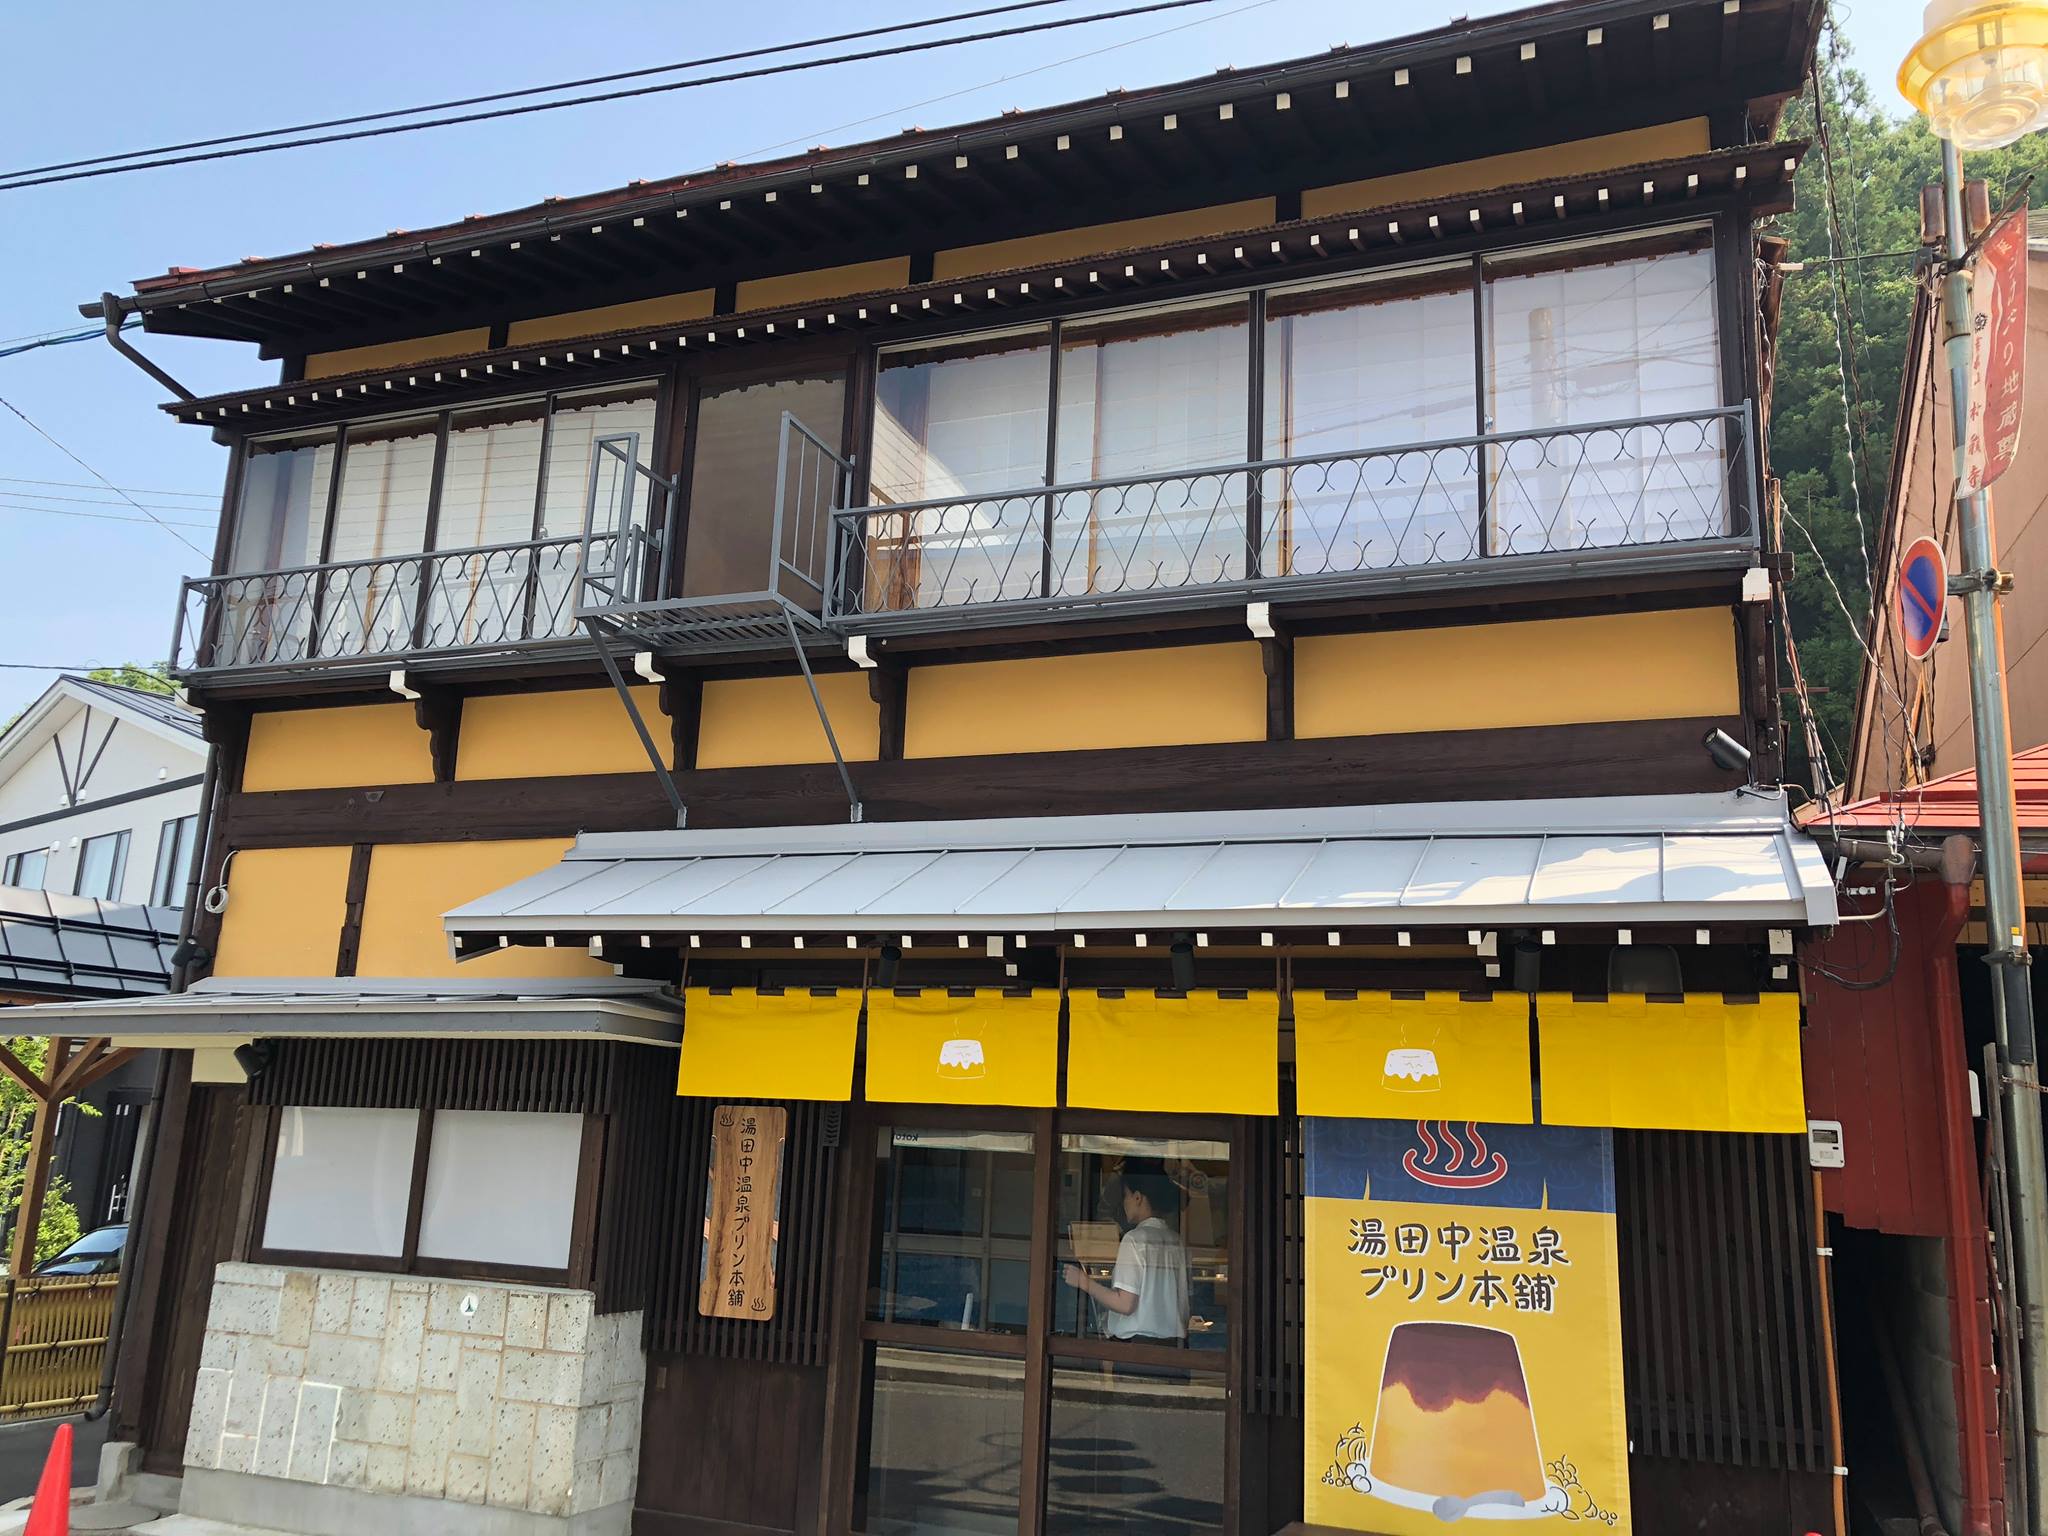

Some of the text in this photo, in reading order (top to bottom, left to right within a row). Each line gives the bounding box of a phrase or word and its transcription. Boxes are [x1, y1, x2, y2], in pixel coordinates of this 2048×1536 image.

[727, 1117, 757, 1307] 湯田中温泉プリン本舗
[1347, 1218, 1570, 1265] 湯田中温泉
[1361, 1265, 1556, 1311] プリン本舗
